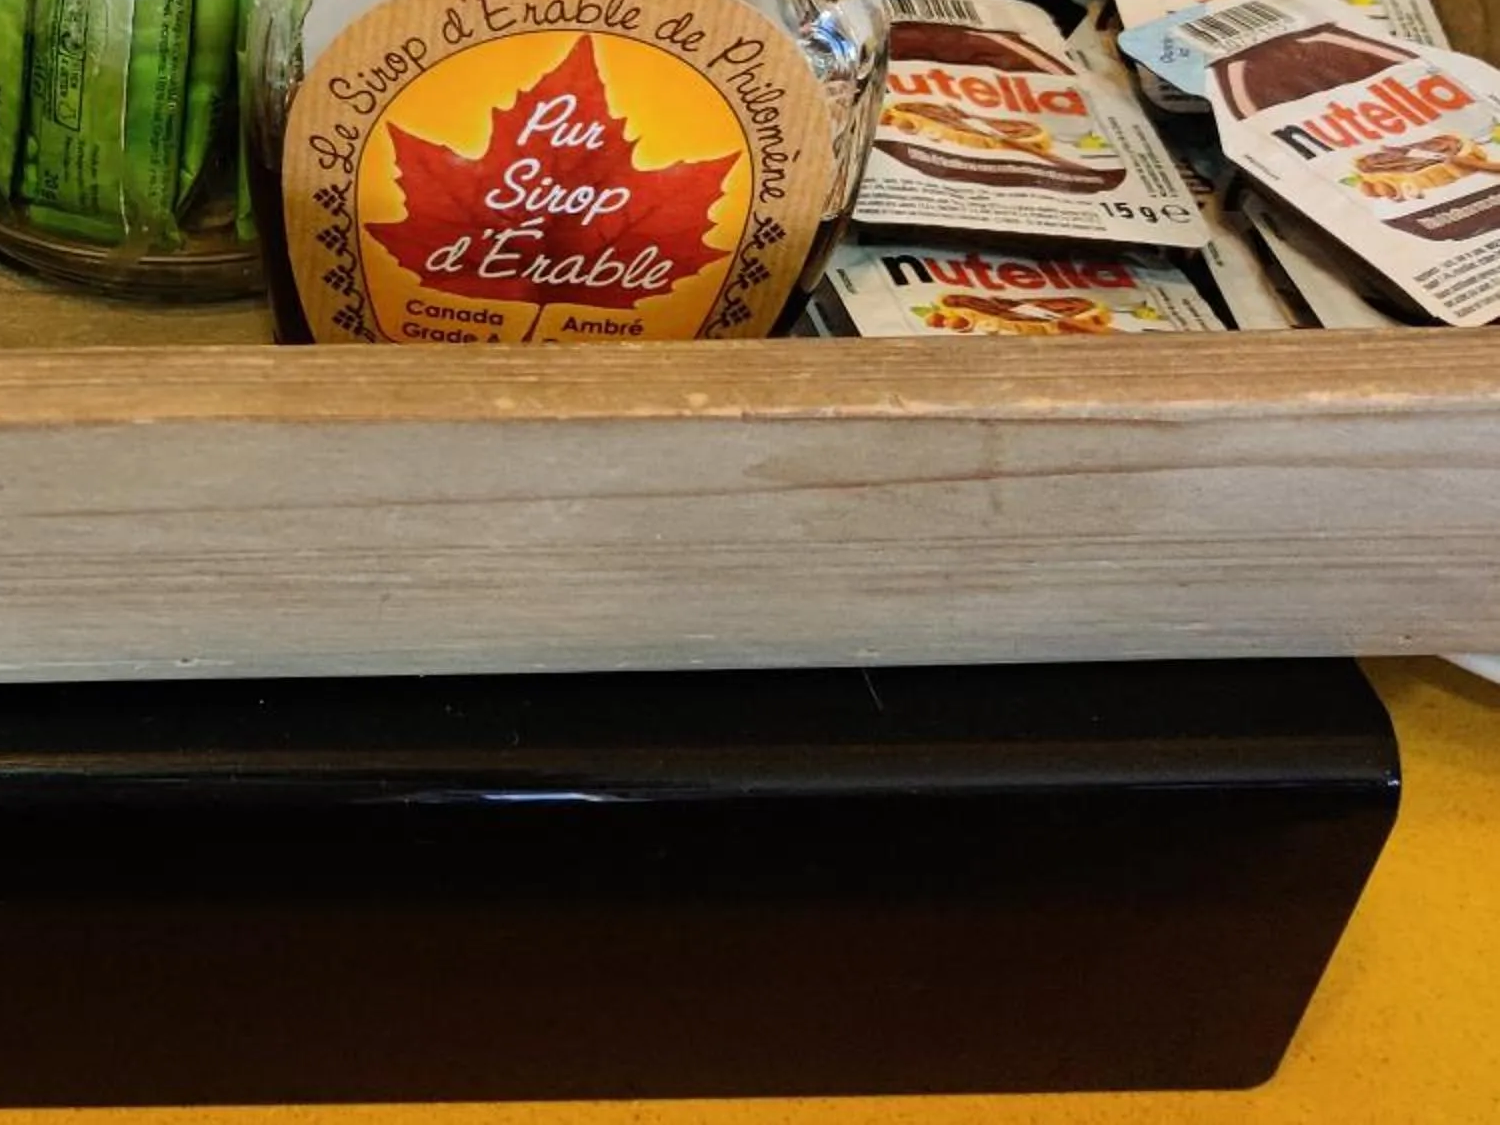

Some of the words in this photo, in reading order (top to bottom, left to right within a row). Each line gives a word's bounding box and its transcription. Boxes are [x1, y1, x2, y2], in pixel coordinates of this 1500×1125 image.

[655, 12, 705, 52] de
[329, 37, 427, 115] Sirop
[885, 68, 1088, 116] utella
[517, 94, 605, 150] Pur
[707, 37, 800, 203] Philomène
[1271, 73, 1476, 160] nutella
[309, 124, 359, 174] Le
[485, 158, 631, 225] Sirop
[425, 217, 674, 289] d'Érable
[882, 253, 1137, 290] nutella
[403, 322, 478, 343] Grade
[406, 299, 504, 325] Canada
[562, 316, 644, 337] Ambré
